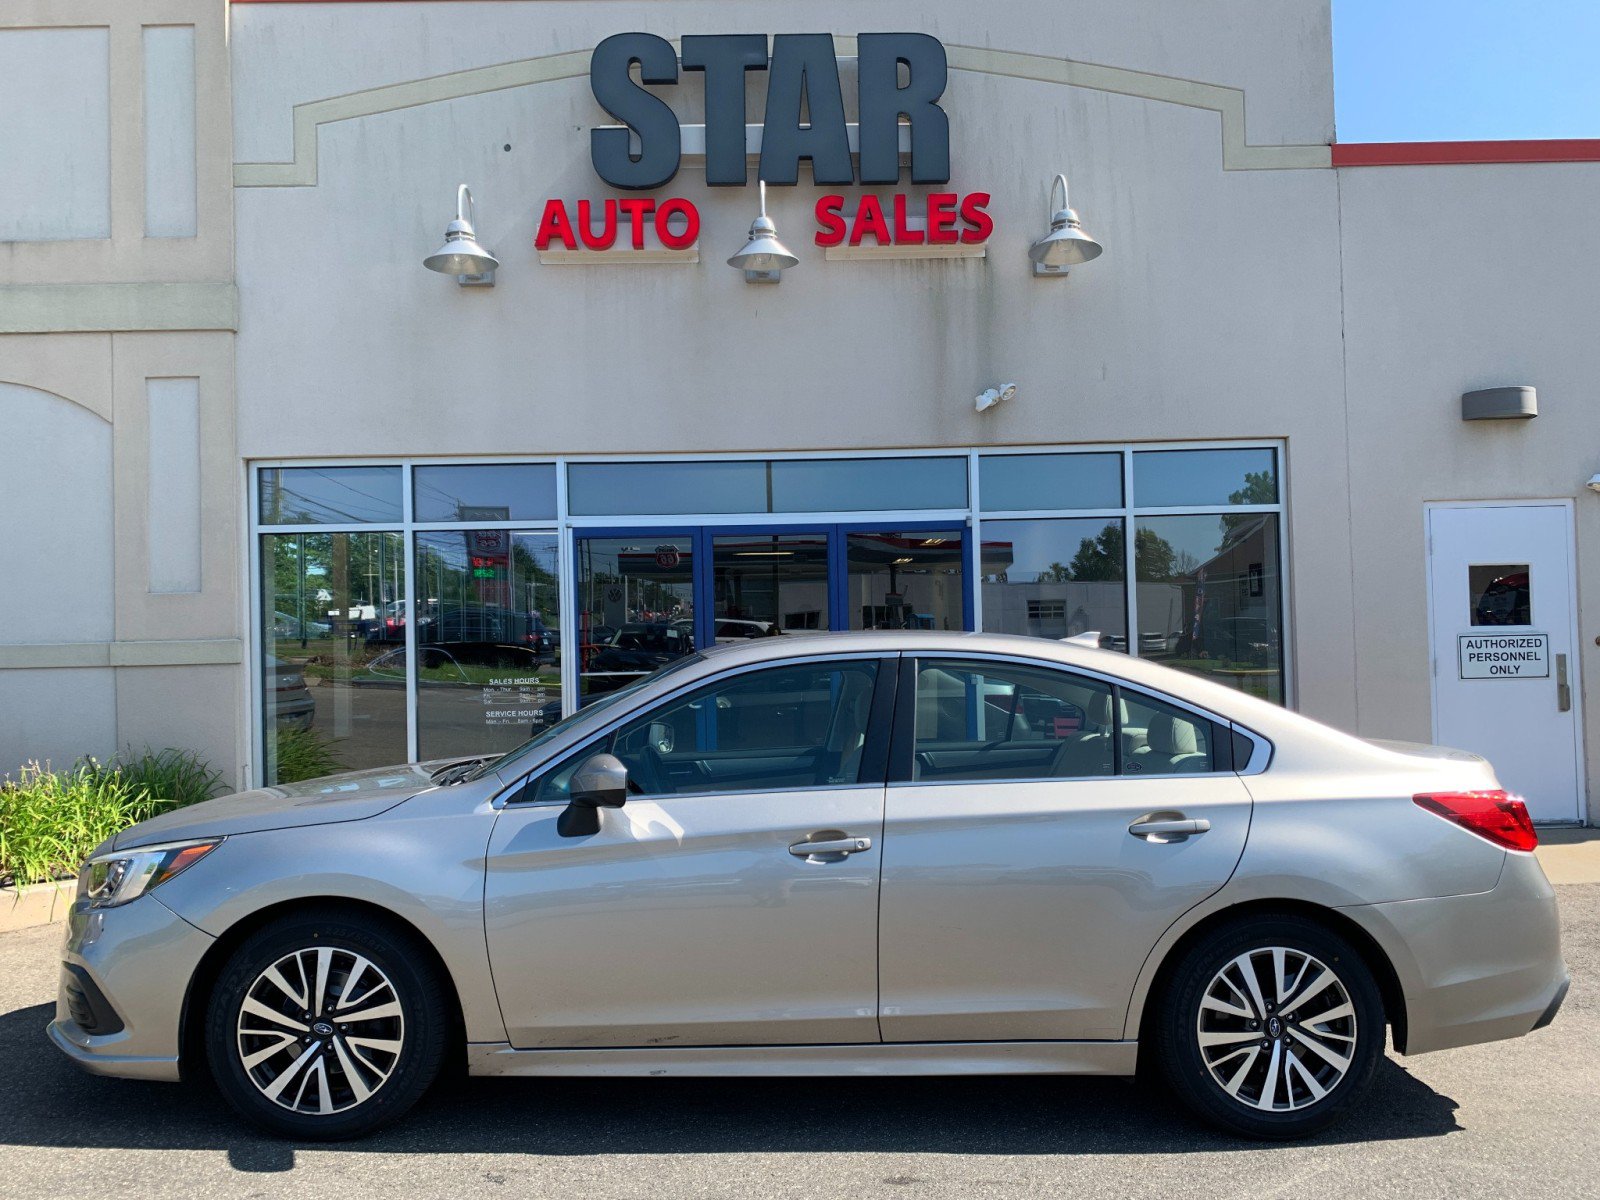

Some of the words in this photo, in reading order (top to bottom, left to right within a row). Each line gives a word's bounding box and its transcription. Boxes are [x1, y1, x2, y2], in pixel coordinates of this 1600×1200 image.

[590, 32, 950, 190] STAR
[534, 197, 701, 251] AUTO
[814, 192, 994, 247] SALES
[1466, 638, 1542, 649] AUTHORIZED
[1468, 651, 1541, 662] PERSONNEL
[1489, 665, 1521, 675] ONLY
[485, 710, 517, 718] SERVICE
